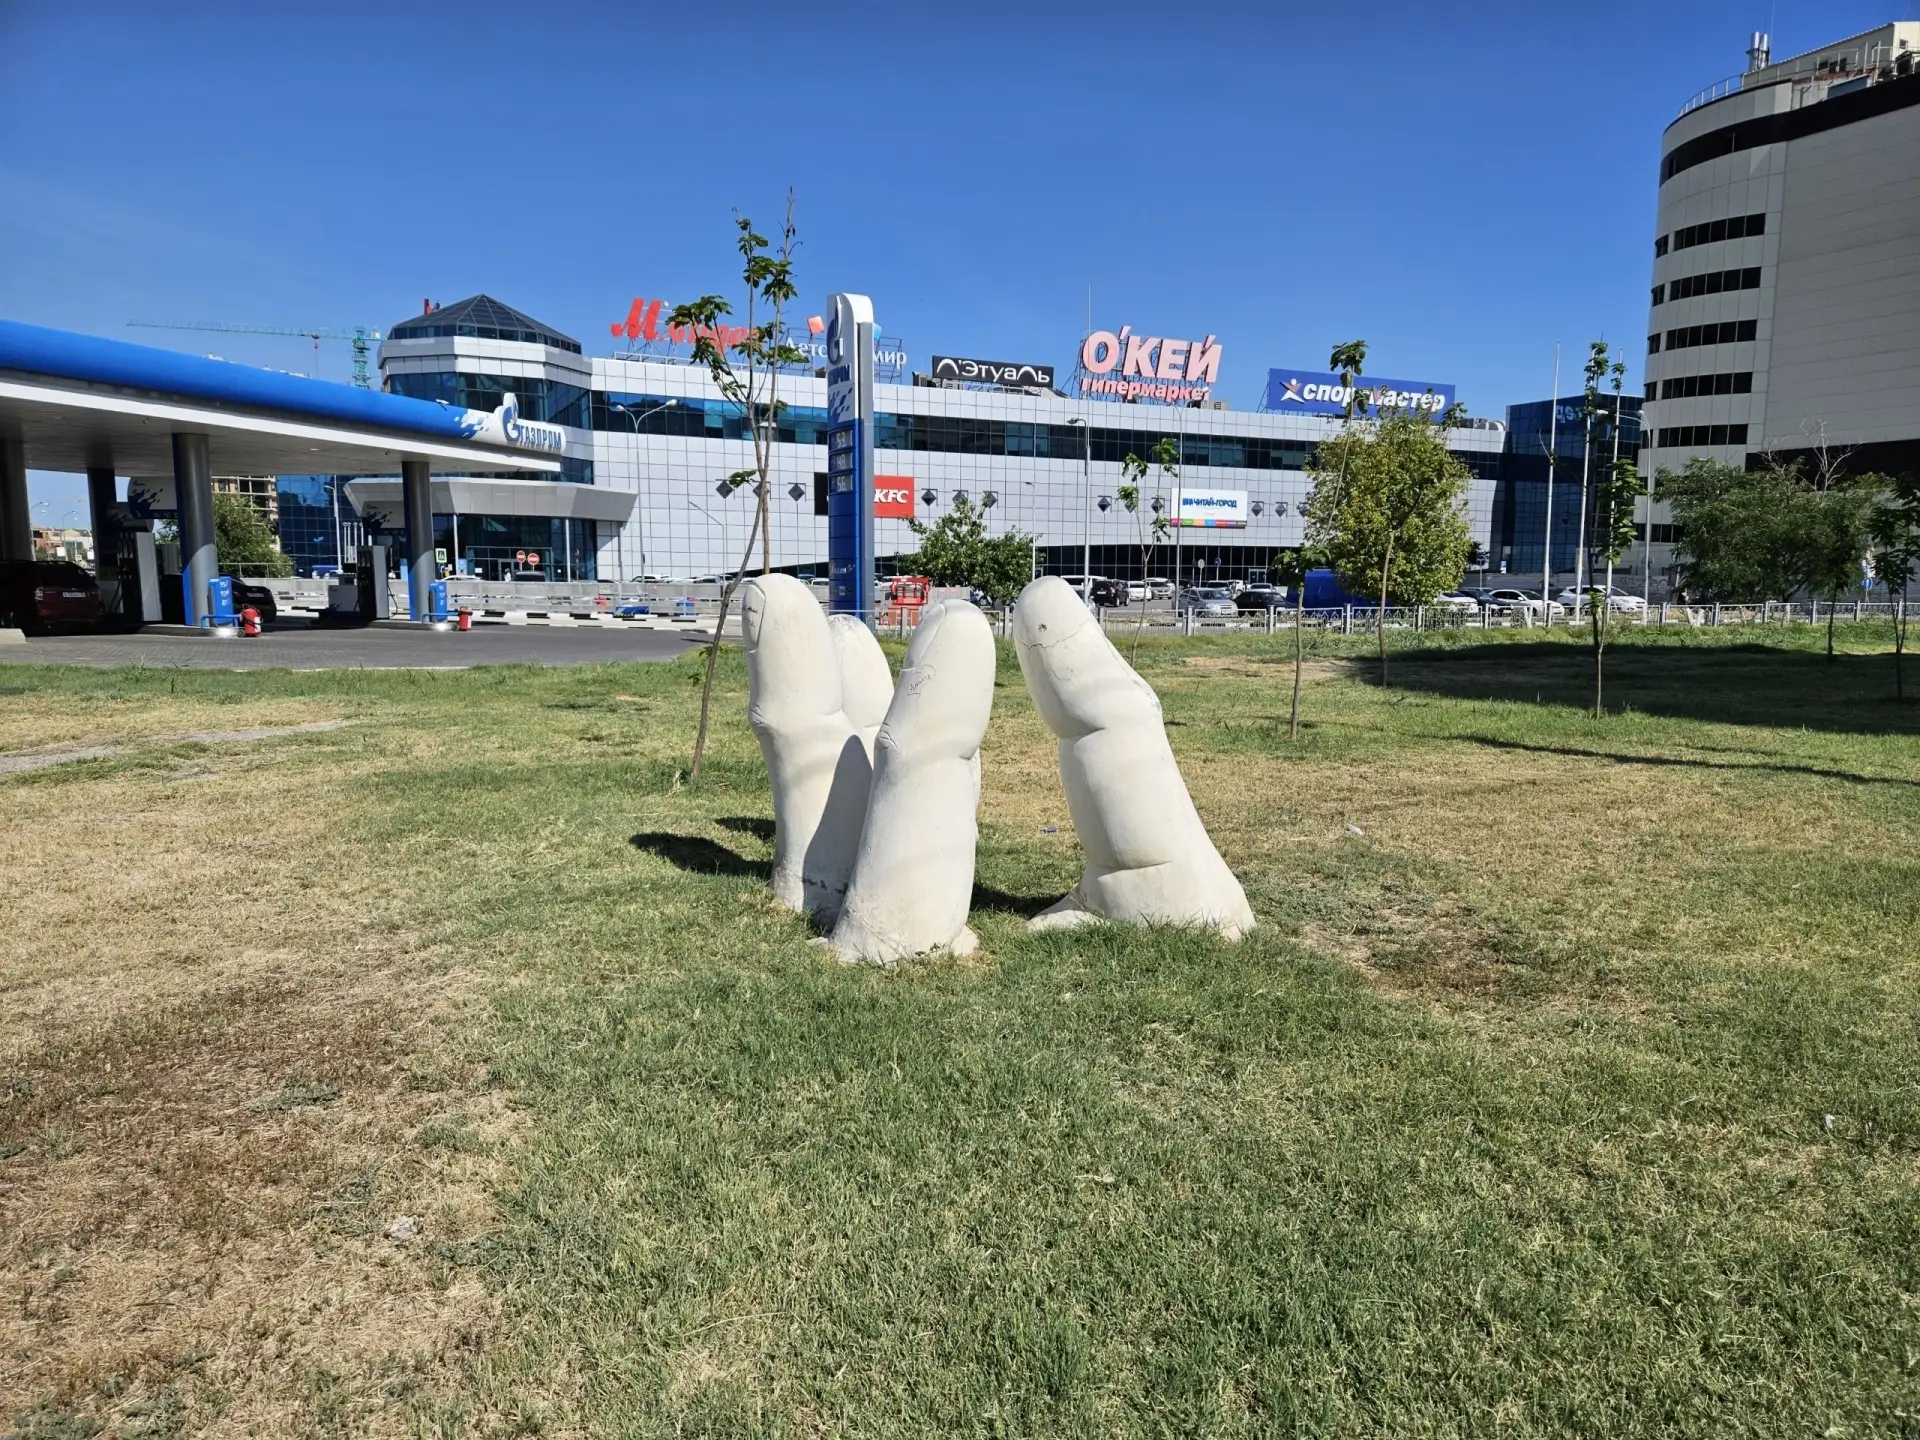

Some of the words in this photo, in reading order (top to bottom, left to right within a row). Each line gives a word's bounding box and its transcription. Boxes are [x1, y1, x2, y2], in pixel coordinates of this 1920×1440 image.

[1303, 383, 1446, 411] спормастер
[519, 424, 562, 449] ГАЗПРОМ
[874, 489, 909, 504] KFC
